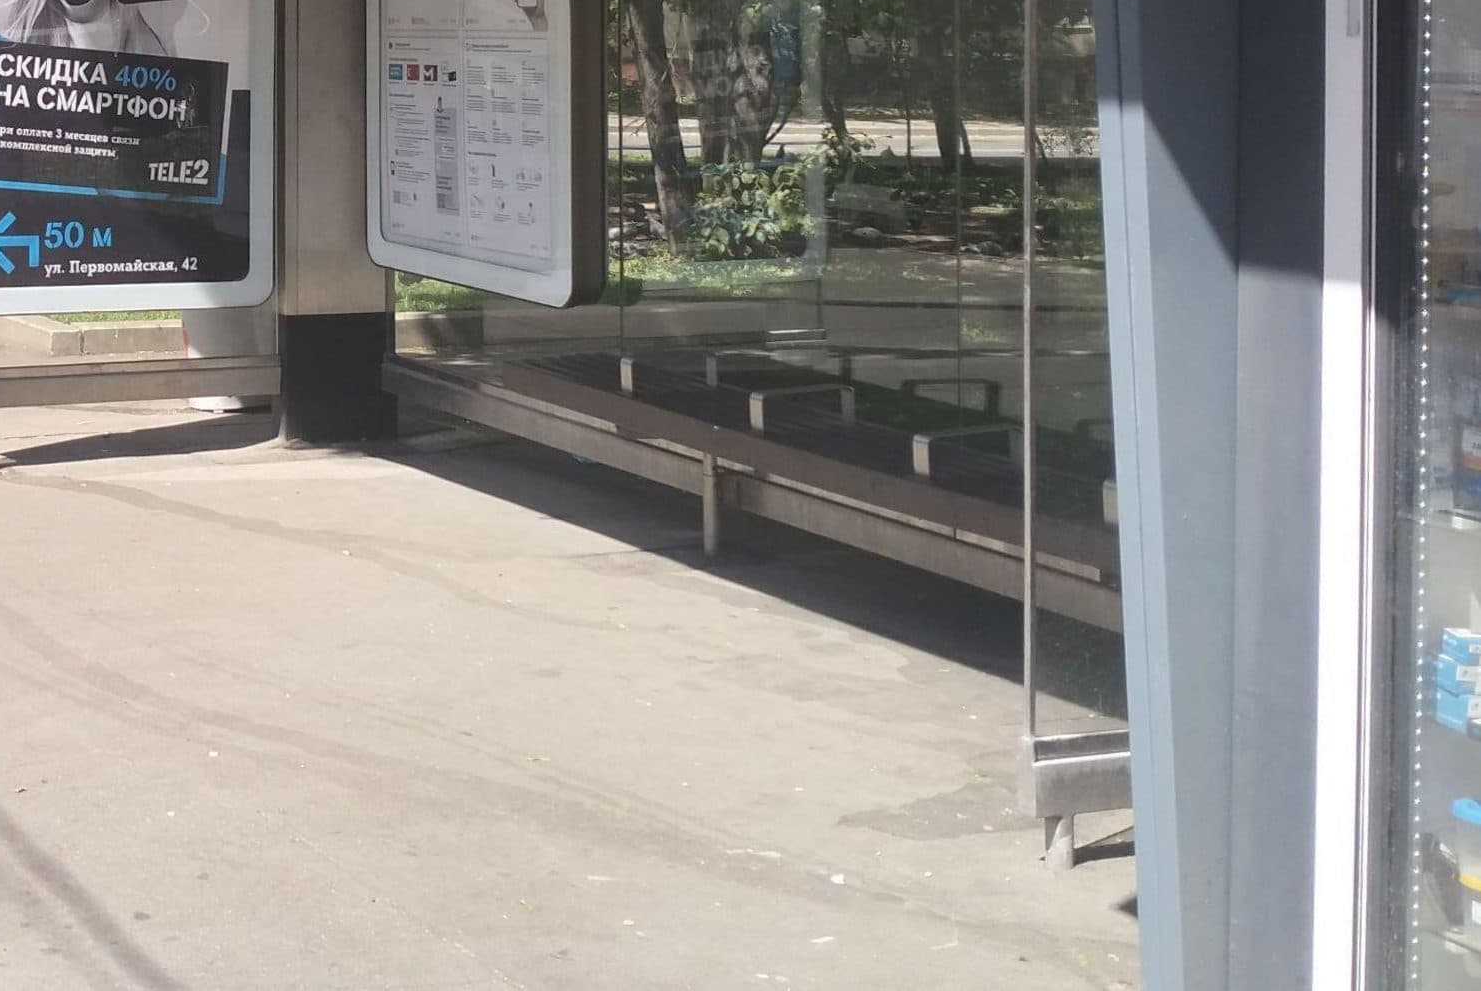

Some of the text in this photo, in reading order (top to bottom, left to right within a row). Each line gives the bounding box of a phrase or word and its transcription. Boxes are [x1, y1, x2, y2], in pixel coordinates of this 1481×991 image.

[114, 64, 177, 92] 40%
[36, 86, 187, 122] СМАРТФОН
[0, 139, 72, 154] комплексной
[15, 127, 54, 139] оплате
[55, 128, 63, 139] 3
[64, 131, 109, 144] месяцев
[111, 135, 141, 146] связи
[148, 159, 209, 185] TELE2
[44, 222, 84, 249] 50
[44, 257, 198, 277] ул. Первомайская, 42
